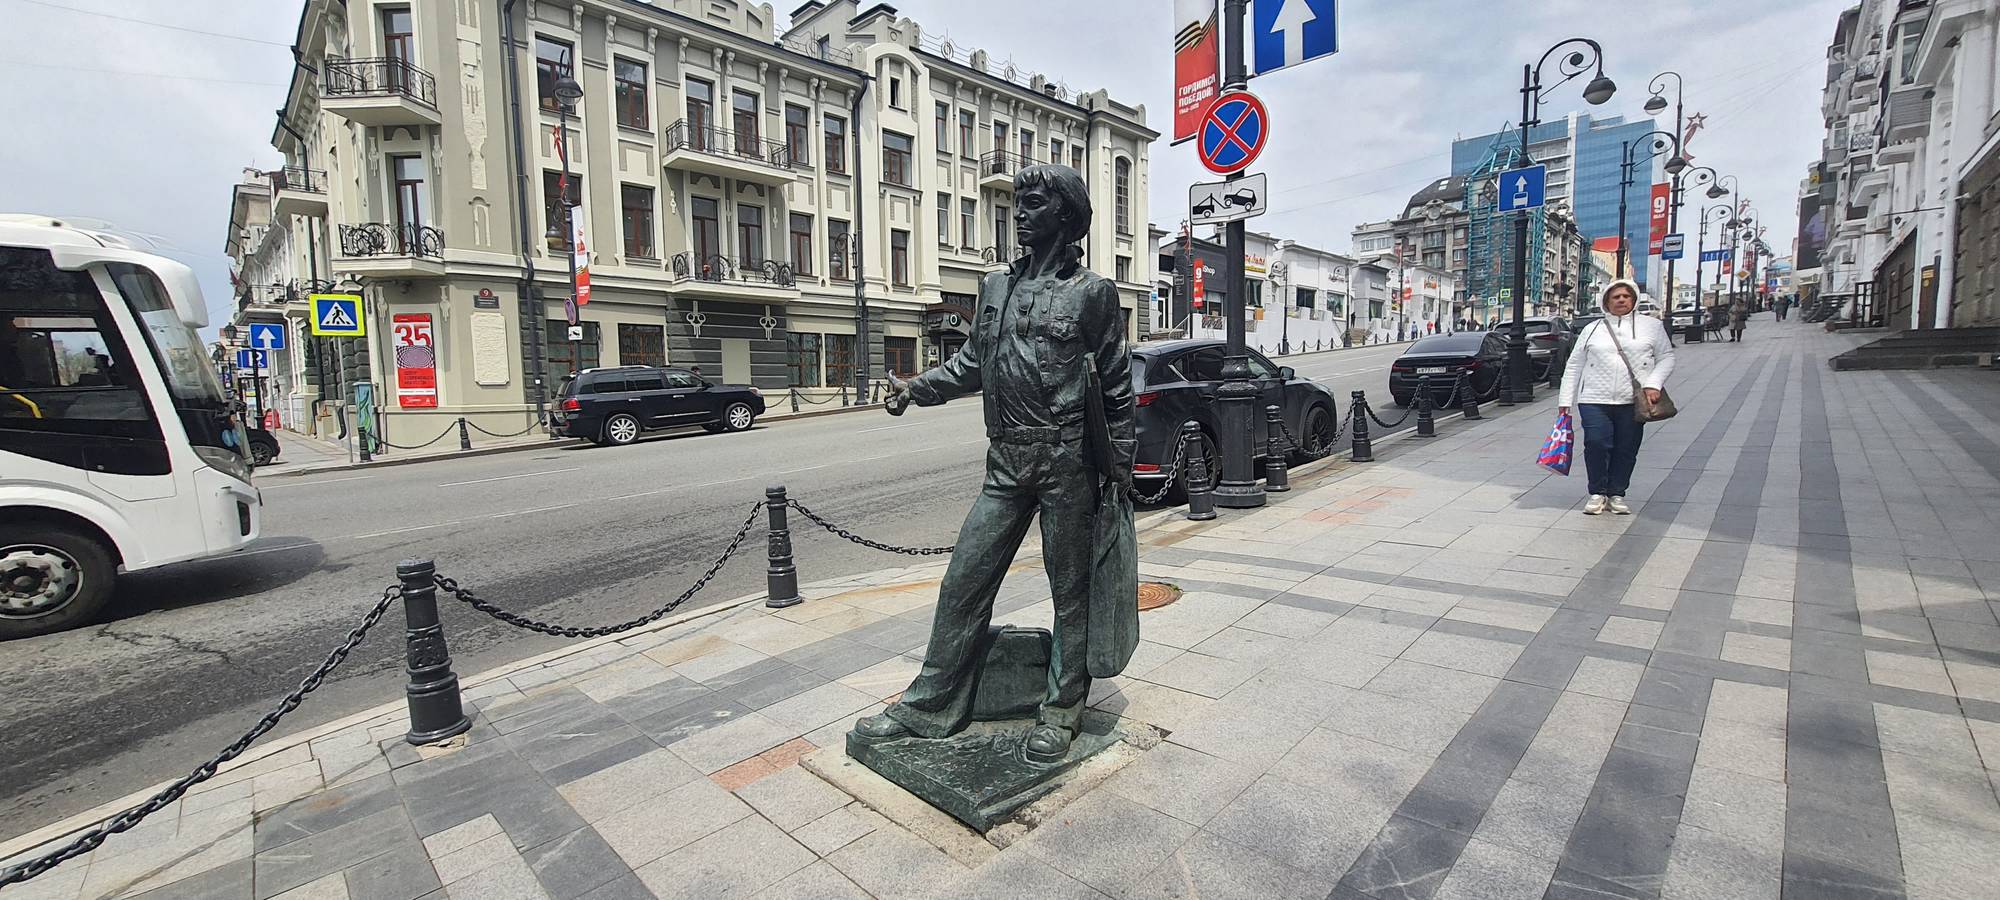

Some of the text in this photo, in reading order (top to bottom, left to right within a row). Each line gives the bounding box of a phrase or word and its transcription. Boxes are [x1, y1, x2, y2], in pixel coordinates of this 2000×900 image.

[1179, 73, 1215, 97] ГОРДИМСЯ
[1653, 196, 1666, 213] 9
[1195, 267, 1202, 279] 9
[395, 324, 431, 347] 35
